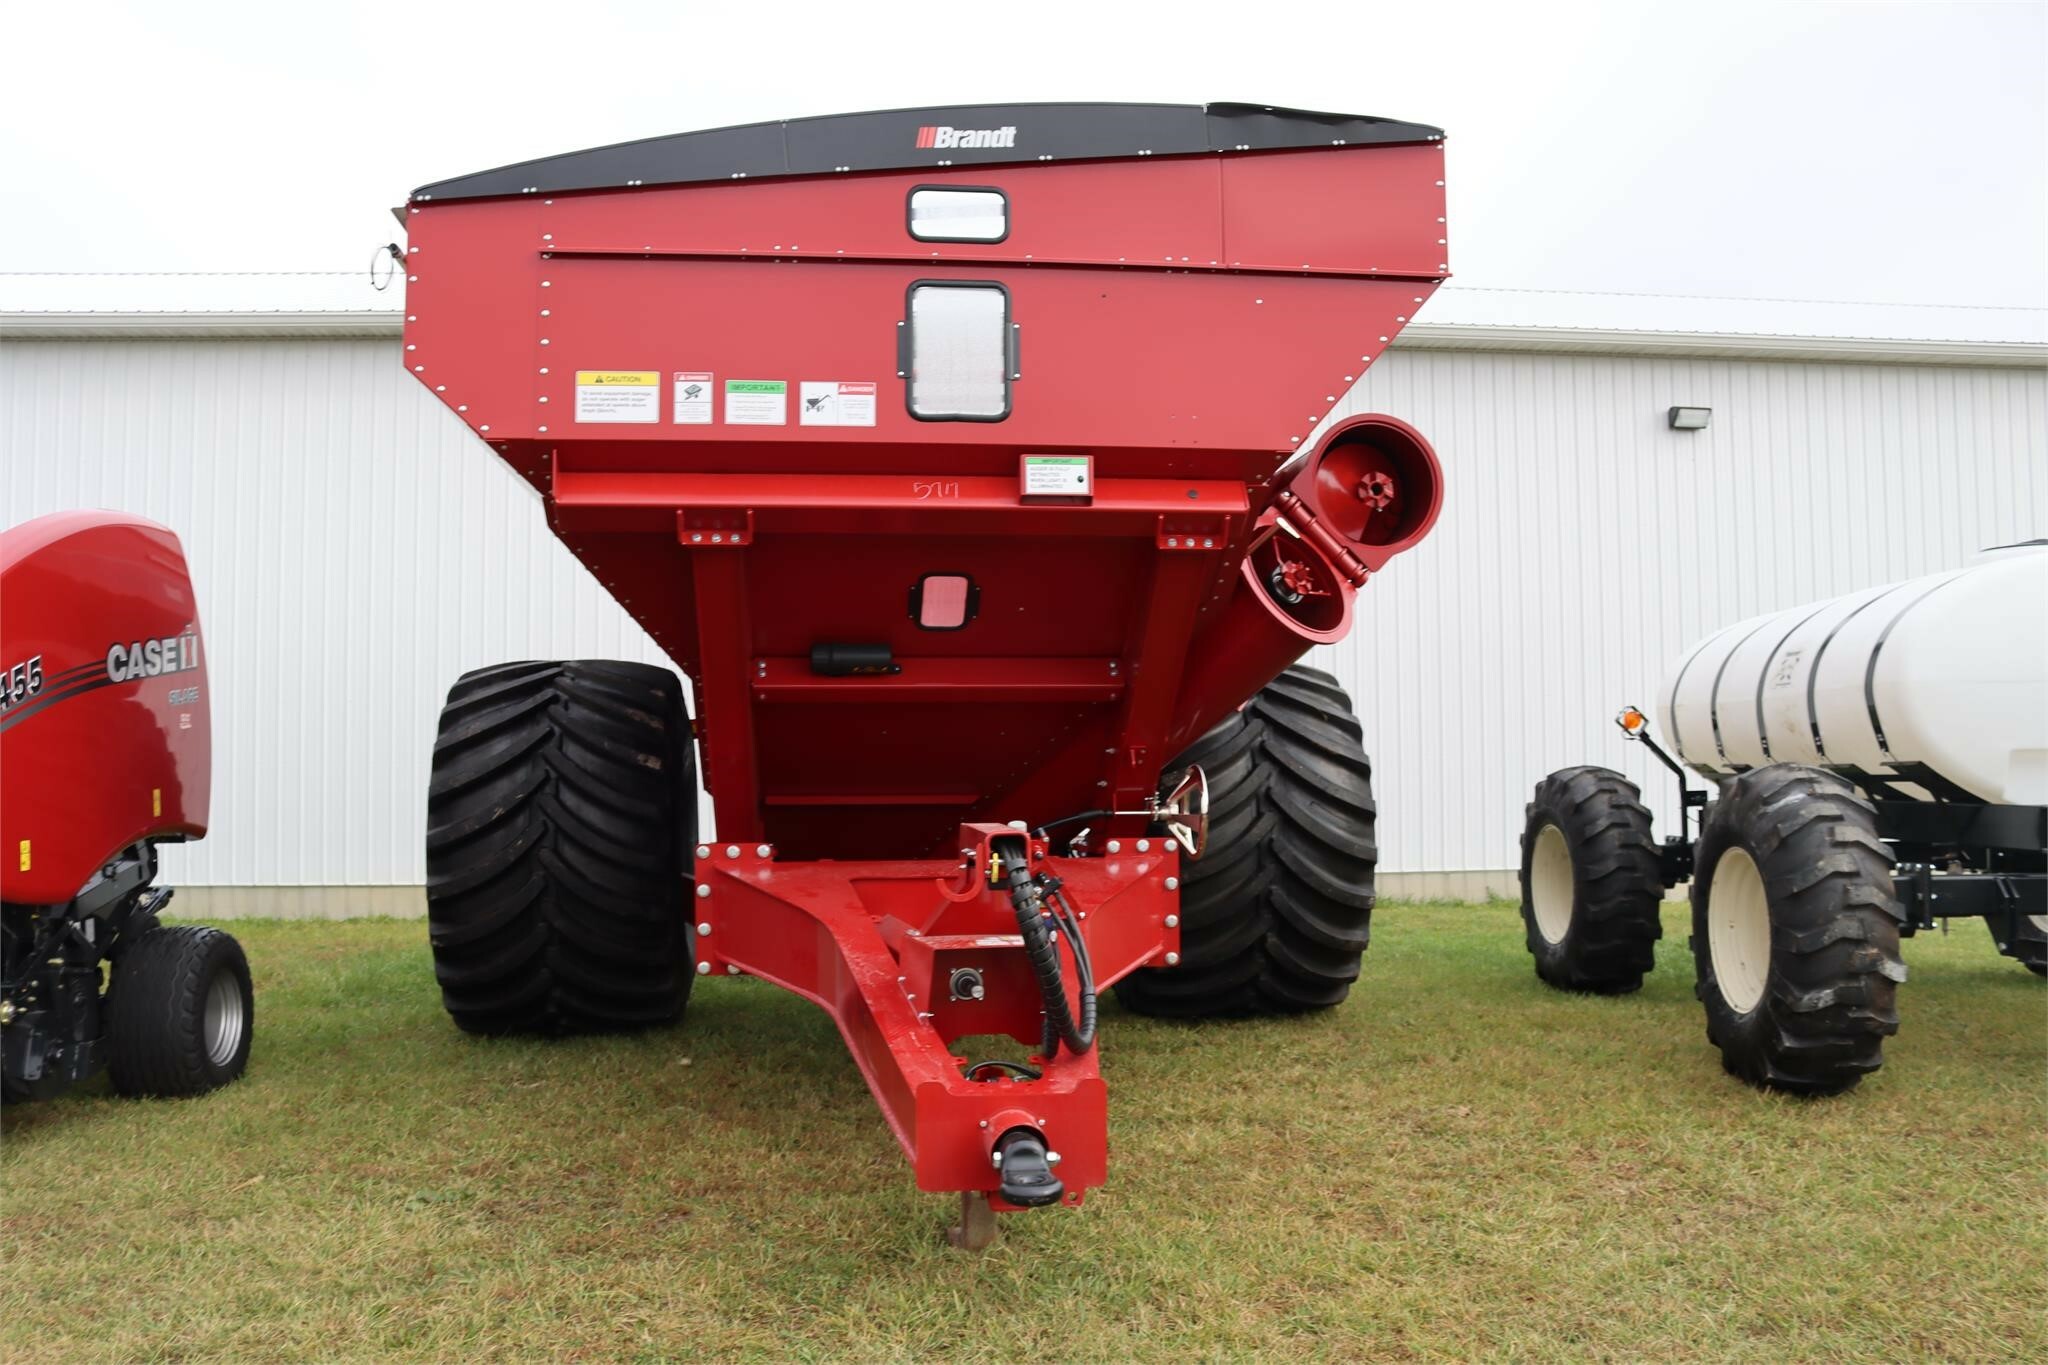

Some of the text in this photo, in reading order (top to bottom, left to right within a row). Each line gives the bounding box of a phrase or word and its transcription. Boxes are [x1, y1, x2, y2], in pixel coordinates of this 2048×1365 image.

[934, 126, 1017, 149] Brandt
[605, 375, 642, 383] CAUTION
[730, 383, 783, 391] IMPORTANT
[106, 637, 178, 683] CASE
